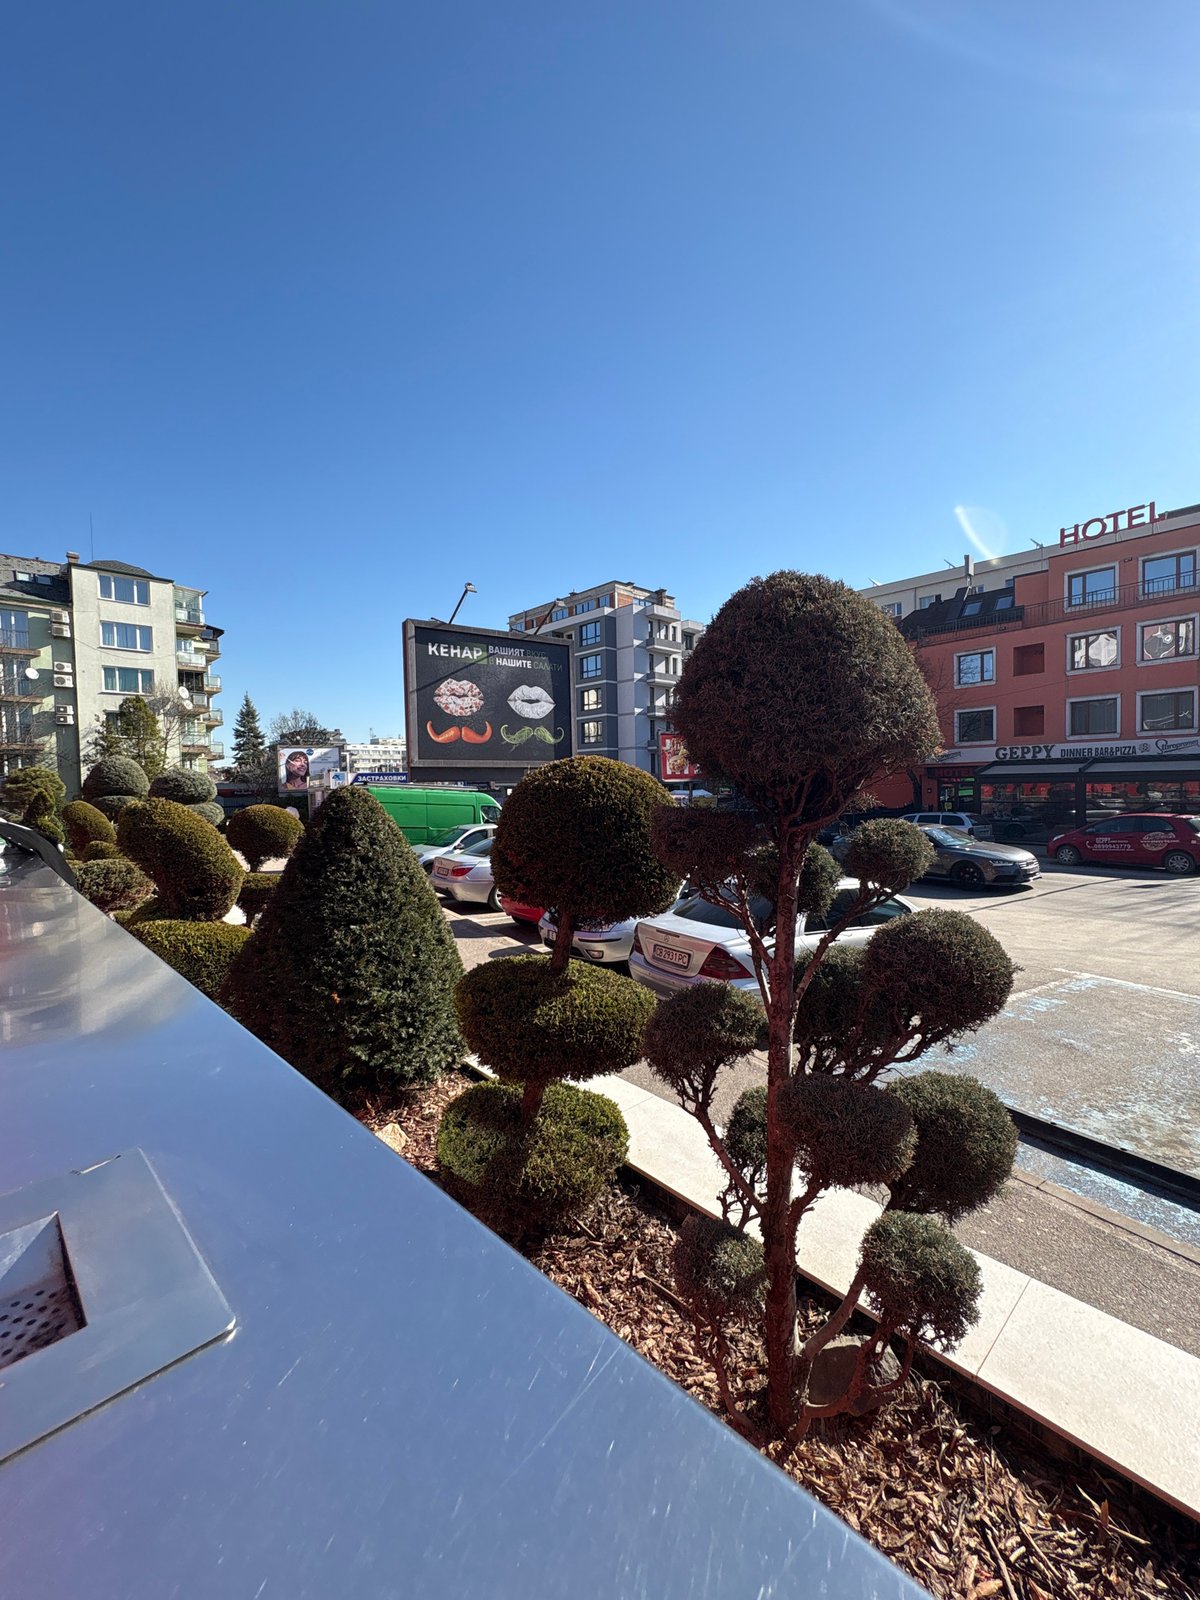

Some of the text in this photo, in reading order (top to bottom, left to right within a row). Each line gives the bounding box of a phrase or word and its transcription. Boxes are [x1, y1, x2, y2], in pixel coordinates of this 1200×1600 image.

[1060, 501, 1165, 548] HOTEL
[428, 642, 483, 660] КЕНАР
[488, 645, 524, 657] ВАШИЯТ
[496, 657, 532, 669] НАШИТЕ
[995, 745, 1054, 760] GEPPY
[1060, 747, 1093, 758] DINNER
